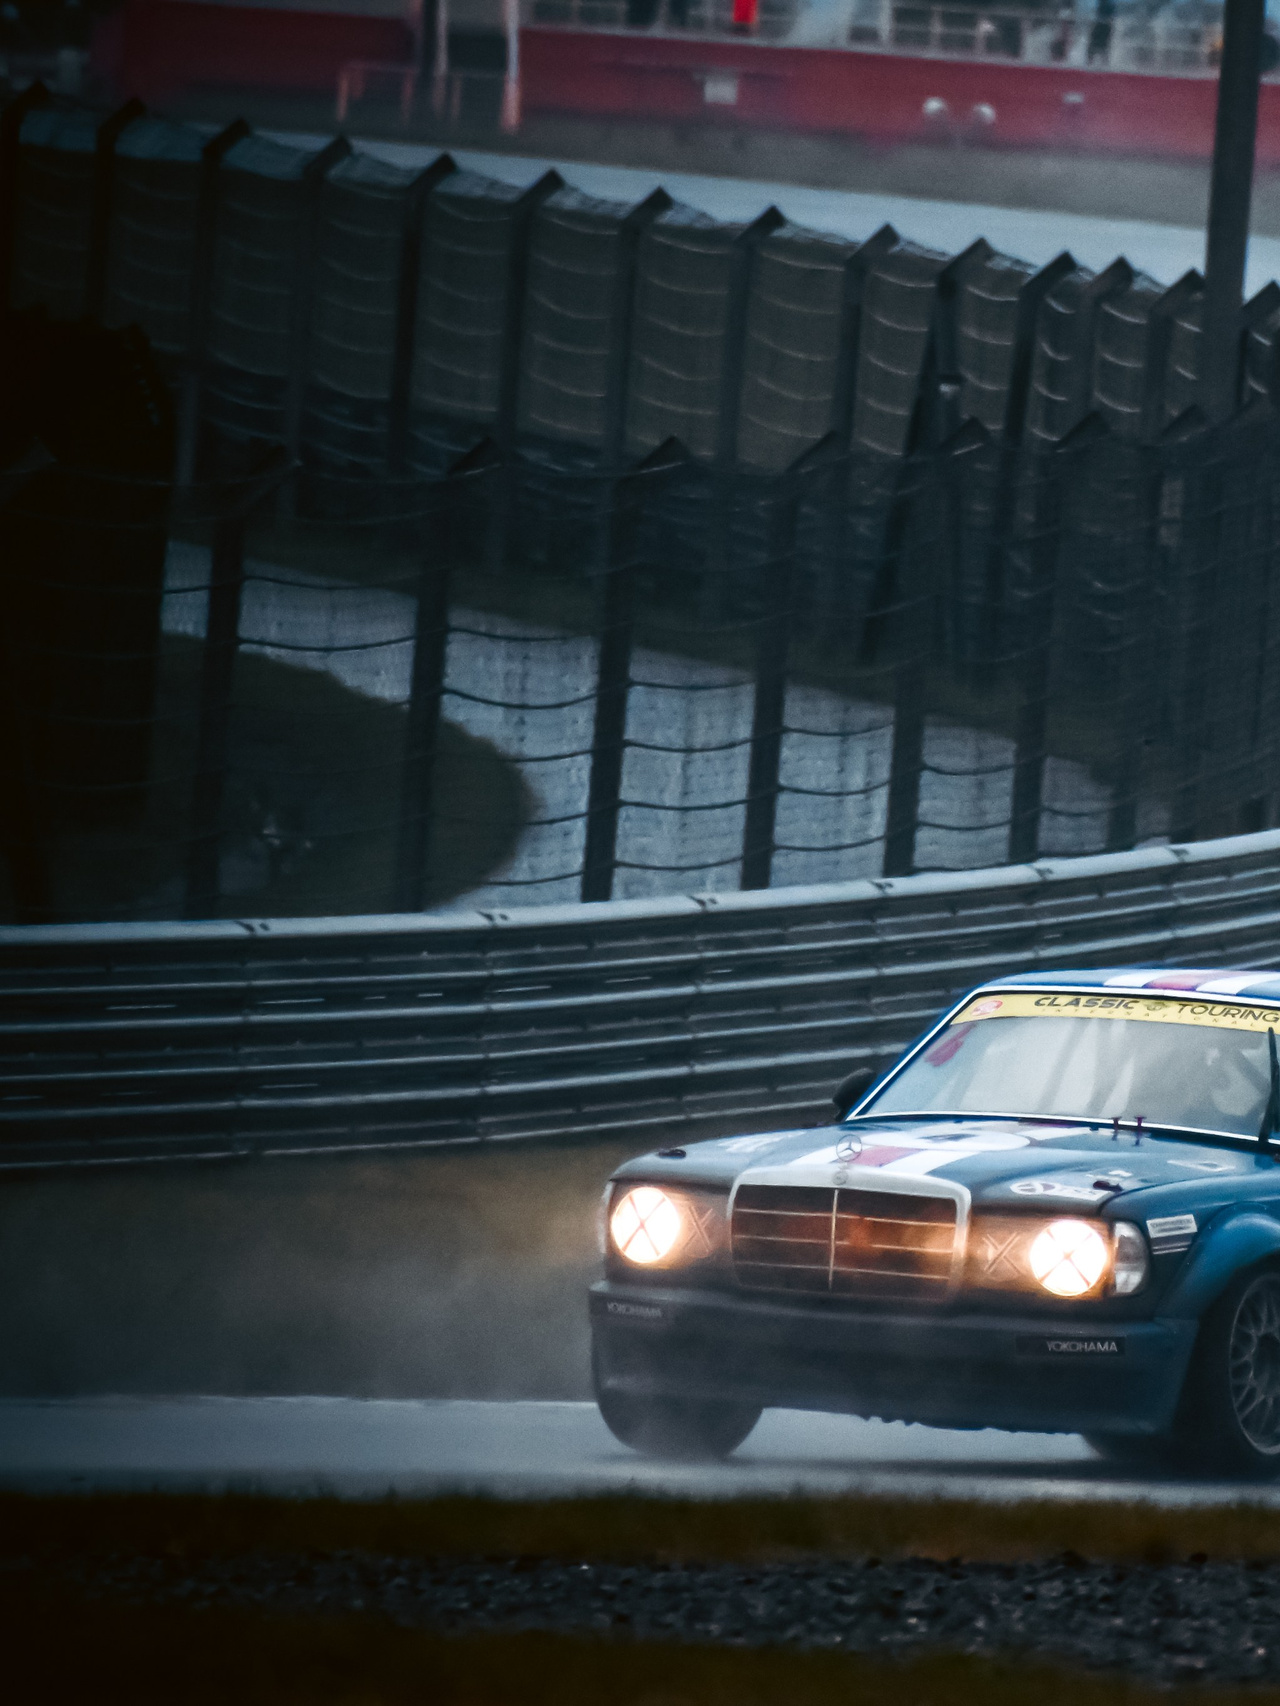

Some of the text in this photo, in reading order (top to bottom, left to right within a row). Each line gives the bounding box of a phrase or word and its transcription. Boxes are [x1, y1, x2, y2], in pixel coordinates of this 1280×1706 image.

[1033, 996, 1280, 1024] CLASSIC TOURING
[1046, 1341, 1118, 1353] YOKOHAMA
